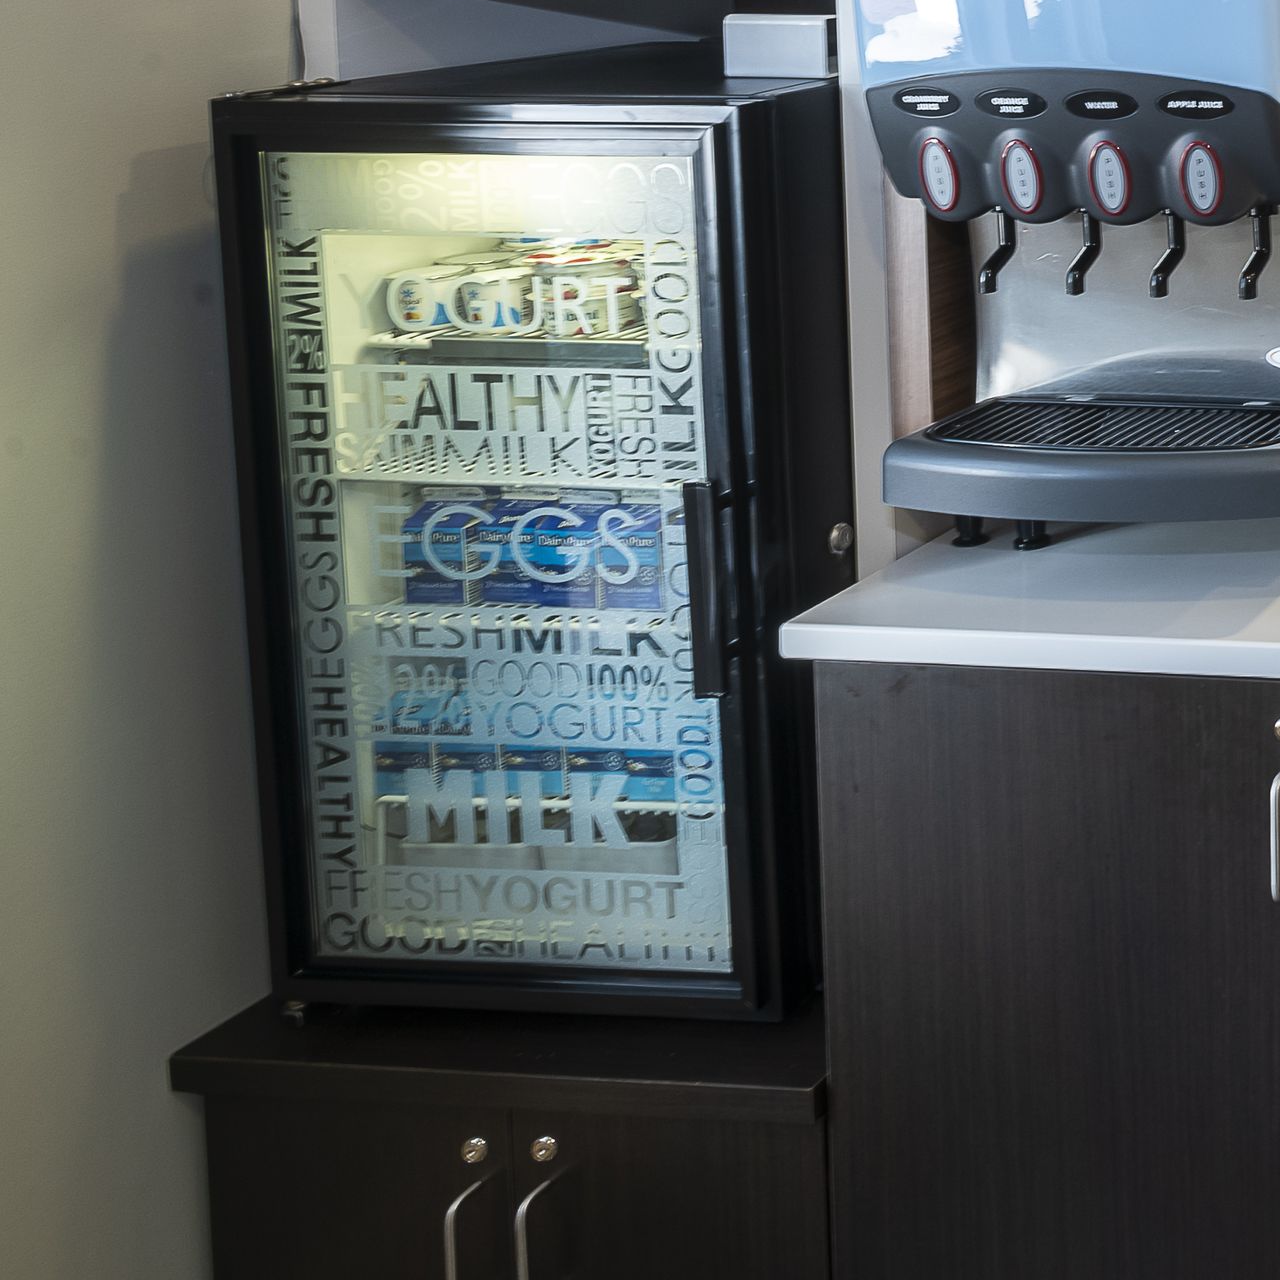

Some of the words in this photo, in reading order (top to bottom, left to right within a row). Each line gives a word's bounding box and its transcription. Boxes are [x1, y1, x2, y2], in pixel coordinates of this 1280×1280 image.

[916, 103, 941, 111] JUICE
[1000, 105, 1025, 113] JUICE
[1166, 100, 1197, 109] APPLE
[1197, 100, 1224, 109] JUICE
[277, 235, 323, 327] MILK
[338, 272, 632, 336] YOGURT
[649, 238, 693, 372] GOOD
[285, 332, 326, 371] 2%
[332, 370, 582, 431] HEALTHY
[615, 374, 657, 479] FRESH
[286, 381, 337, 543] FRESH
[368, 503, 645, 586] EGGS
[301, 550, 346, 679] EGGS
[510, 612, 669, 658] MILK
[471, 658, 583, 699] GOOD
[585, 662, 669, 702] 100%
[479, 700, 668, 743] YOGURT
[310, 685, 357, 868] HEALTHY
[405, 768, 632, 850] MILK
[463, 872, 686, 919] YOGURT
